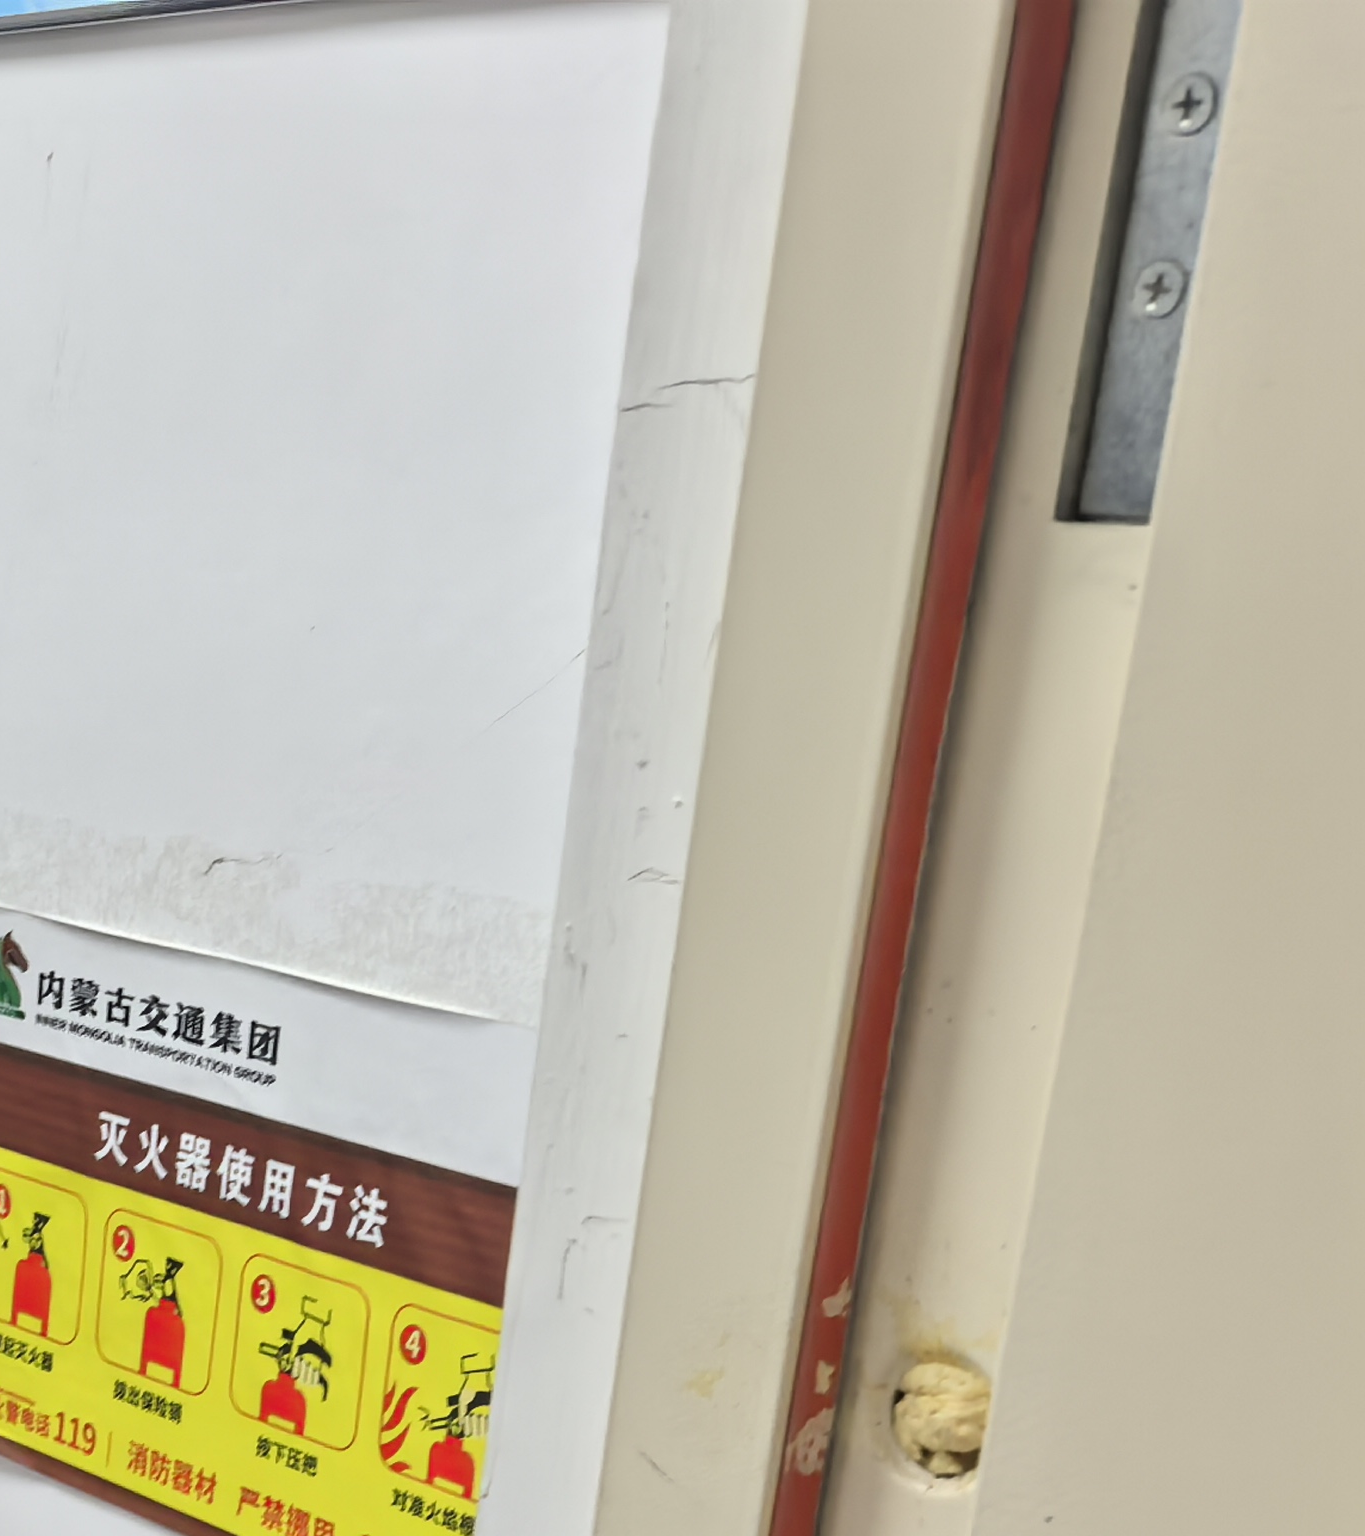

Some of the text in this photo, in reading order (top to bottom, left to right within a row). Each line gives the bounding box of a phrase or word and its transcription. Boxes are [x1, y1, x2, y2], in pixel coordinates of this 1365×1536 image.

[36, 969, 282, 1066] 内蒙古交通集团
[127, 1036, 233, 1077] TRANSPORTATION
[93, 1109, 390, 1248] 灭火器使用方法
[116, 1228, 129, 1258] 2
[255, 1278, 272, 1309] 3
[404, 1329, 422, 1359] 4
[126, 1439, 218, 1505] 消防器材
